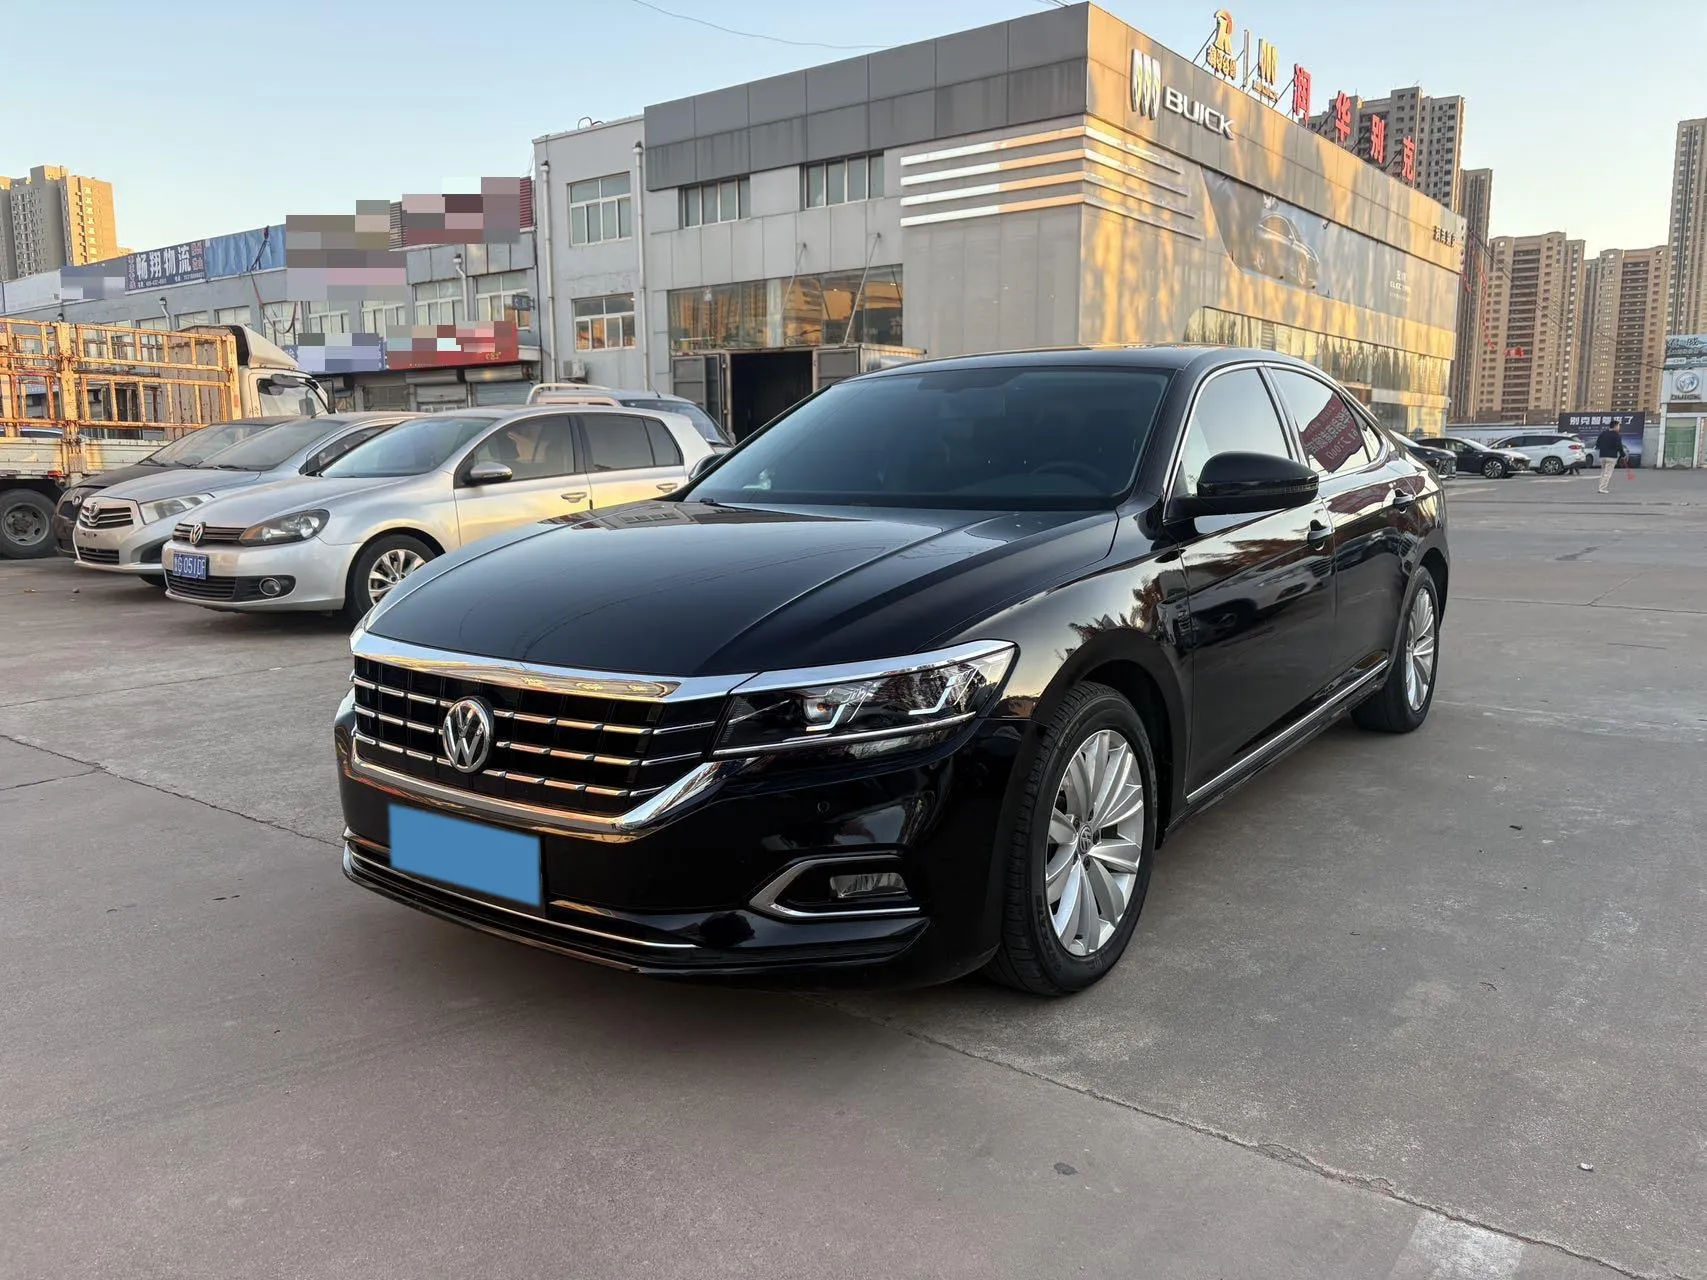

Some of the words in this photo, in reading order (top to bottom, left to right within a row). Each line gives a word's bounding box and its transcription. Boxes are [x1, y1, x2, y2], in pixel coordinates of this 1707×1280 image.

[1164, 86, 1235, 140] BUICK
[136, 245, 192, 281] 畅翔物流
